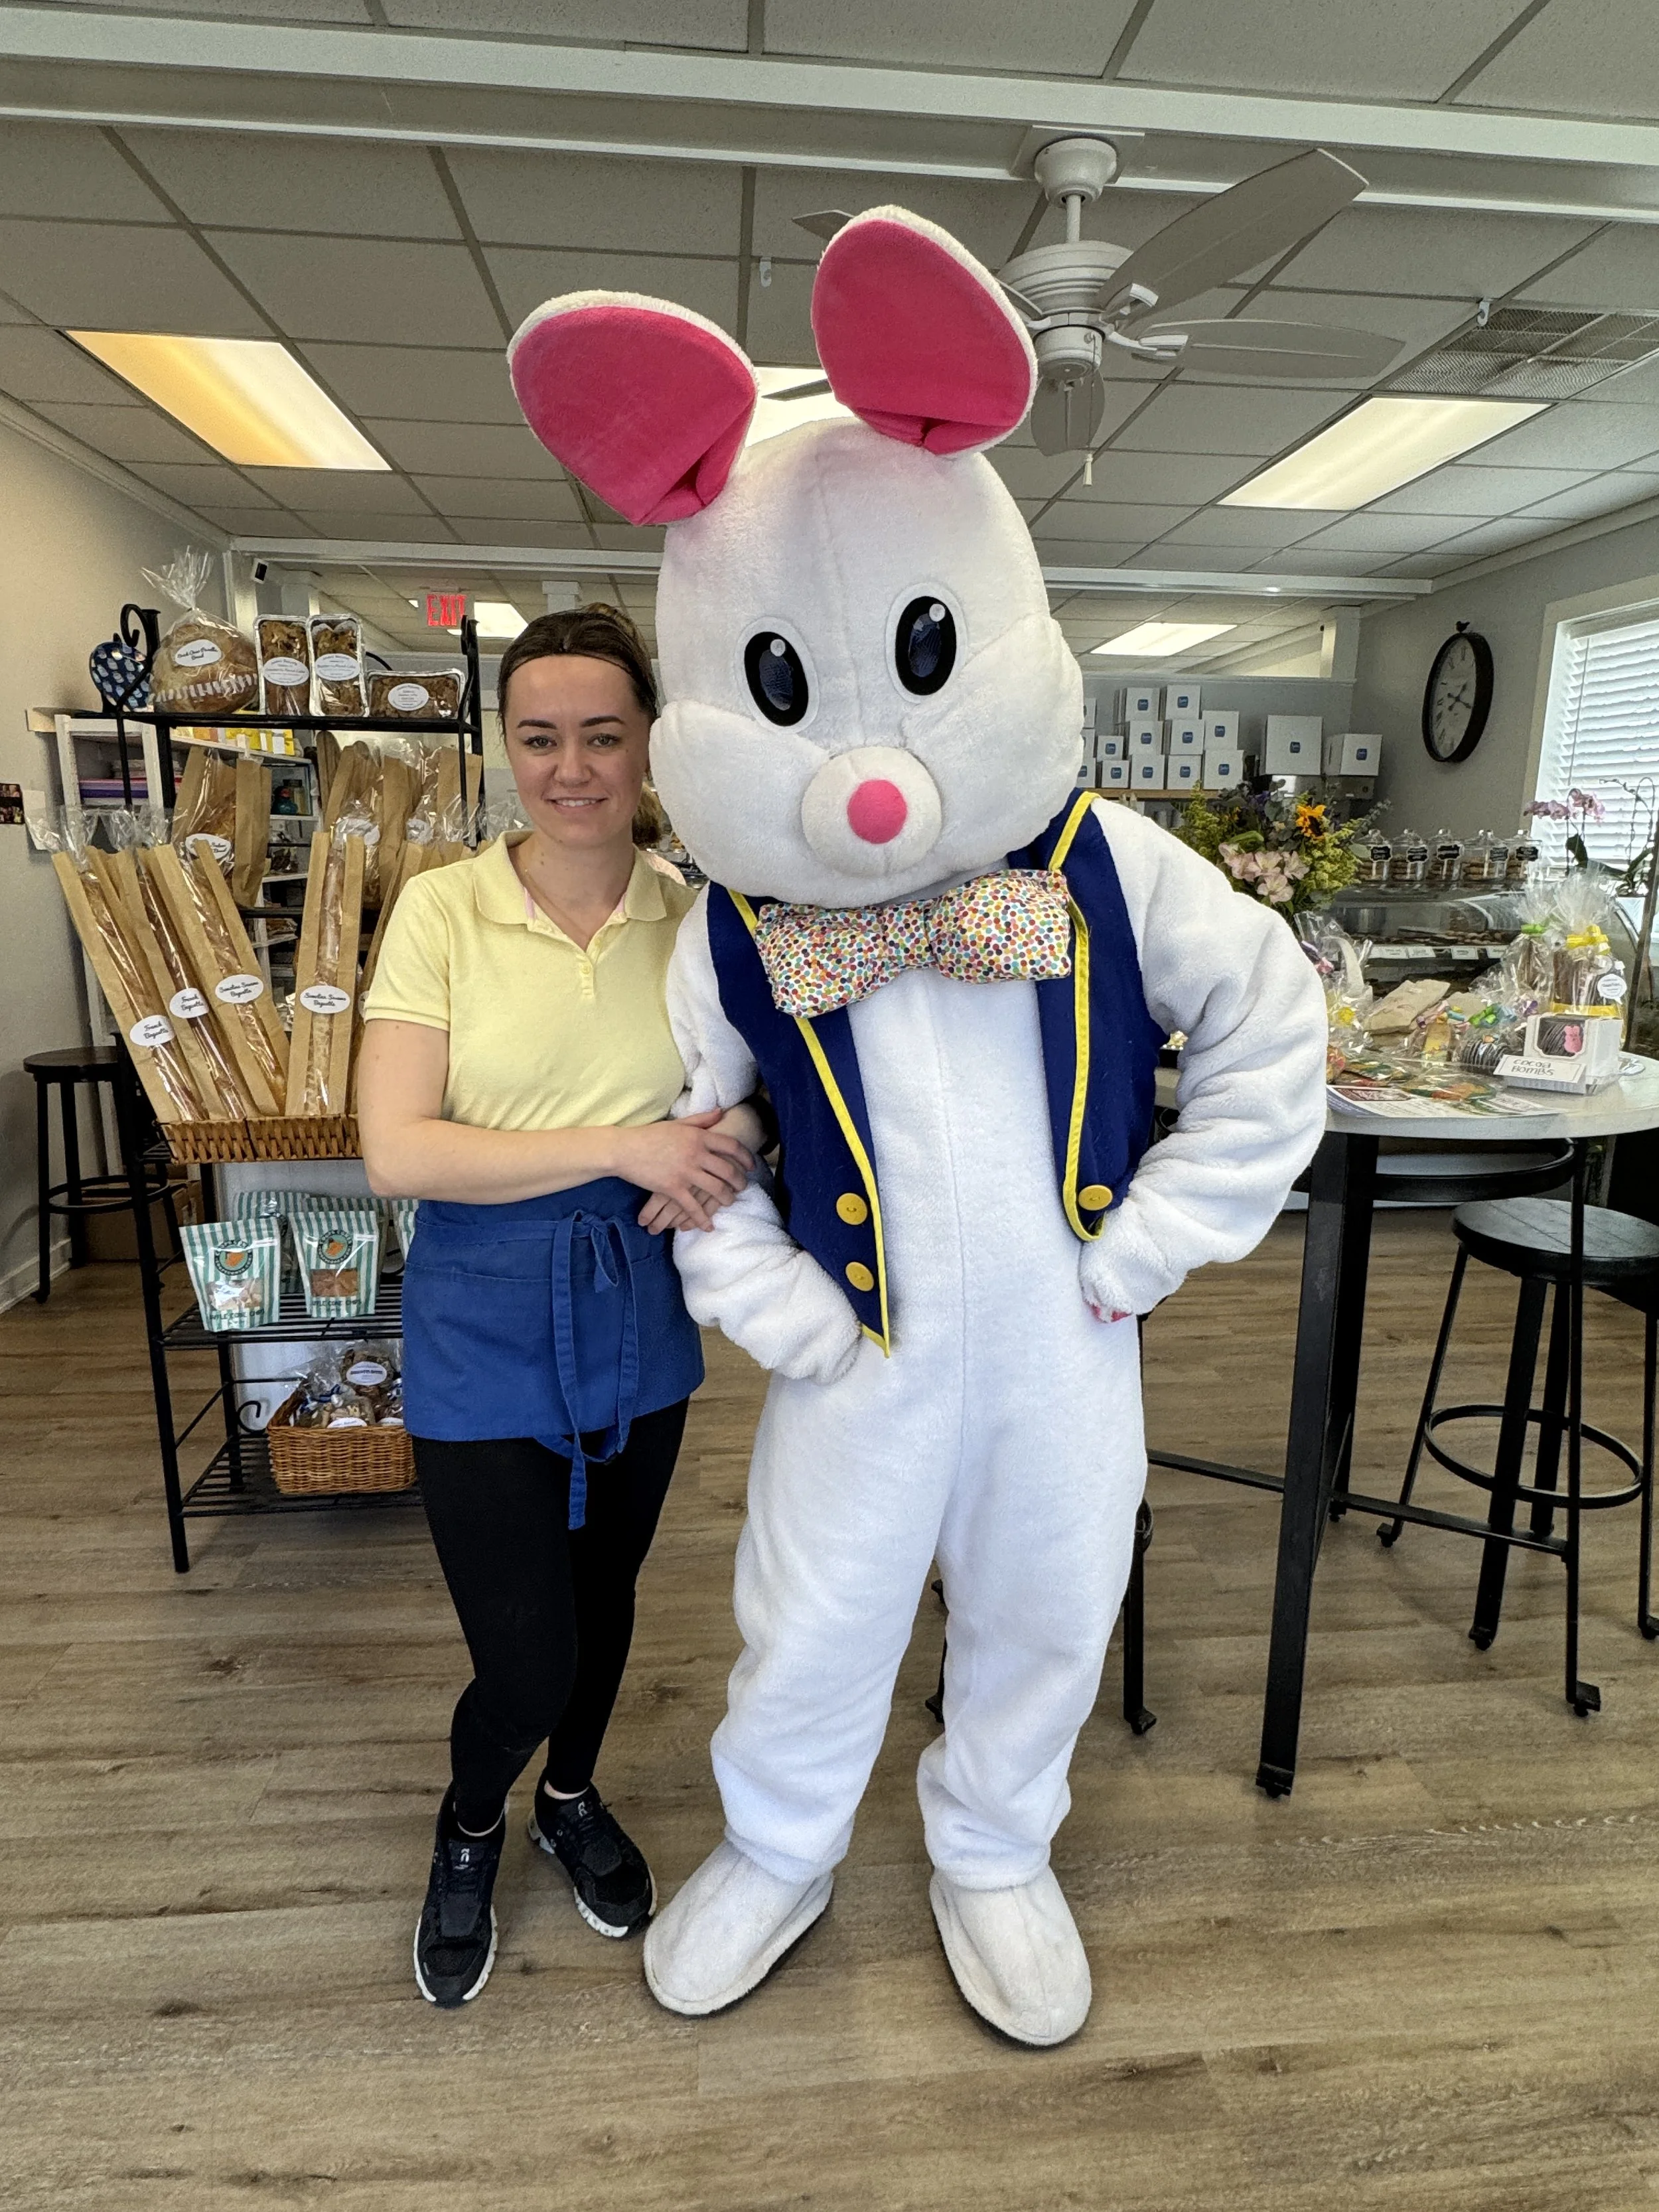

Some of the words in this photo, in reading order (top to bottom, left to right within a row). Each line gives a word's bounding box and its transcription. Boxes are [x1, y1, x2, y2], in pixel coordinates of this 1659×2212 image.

[427, 594, 467, 627] EXIT
[230, 988, 252, 998] Baguette
[181, 994, 199, 1004] French
[180, 1001, 204, 1011] Baguette
[144, 1021, 163, 1031] French
[143, 1028, 169, 1039] Baguette
